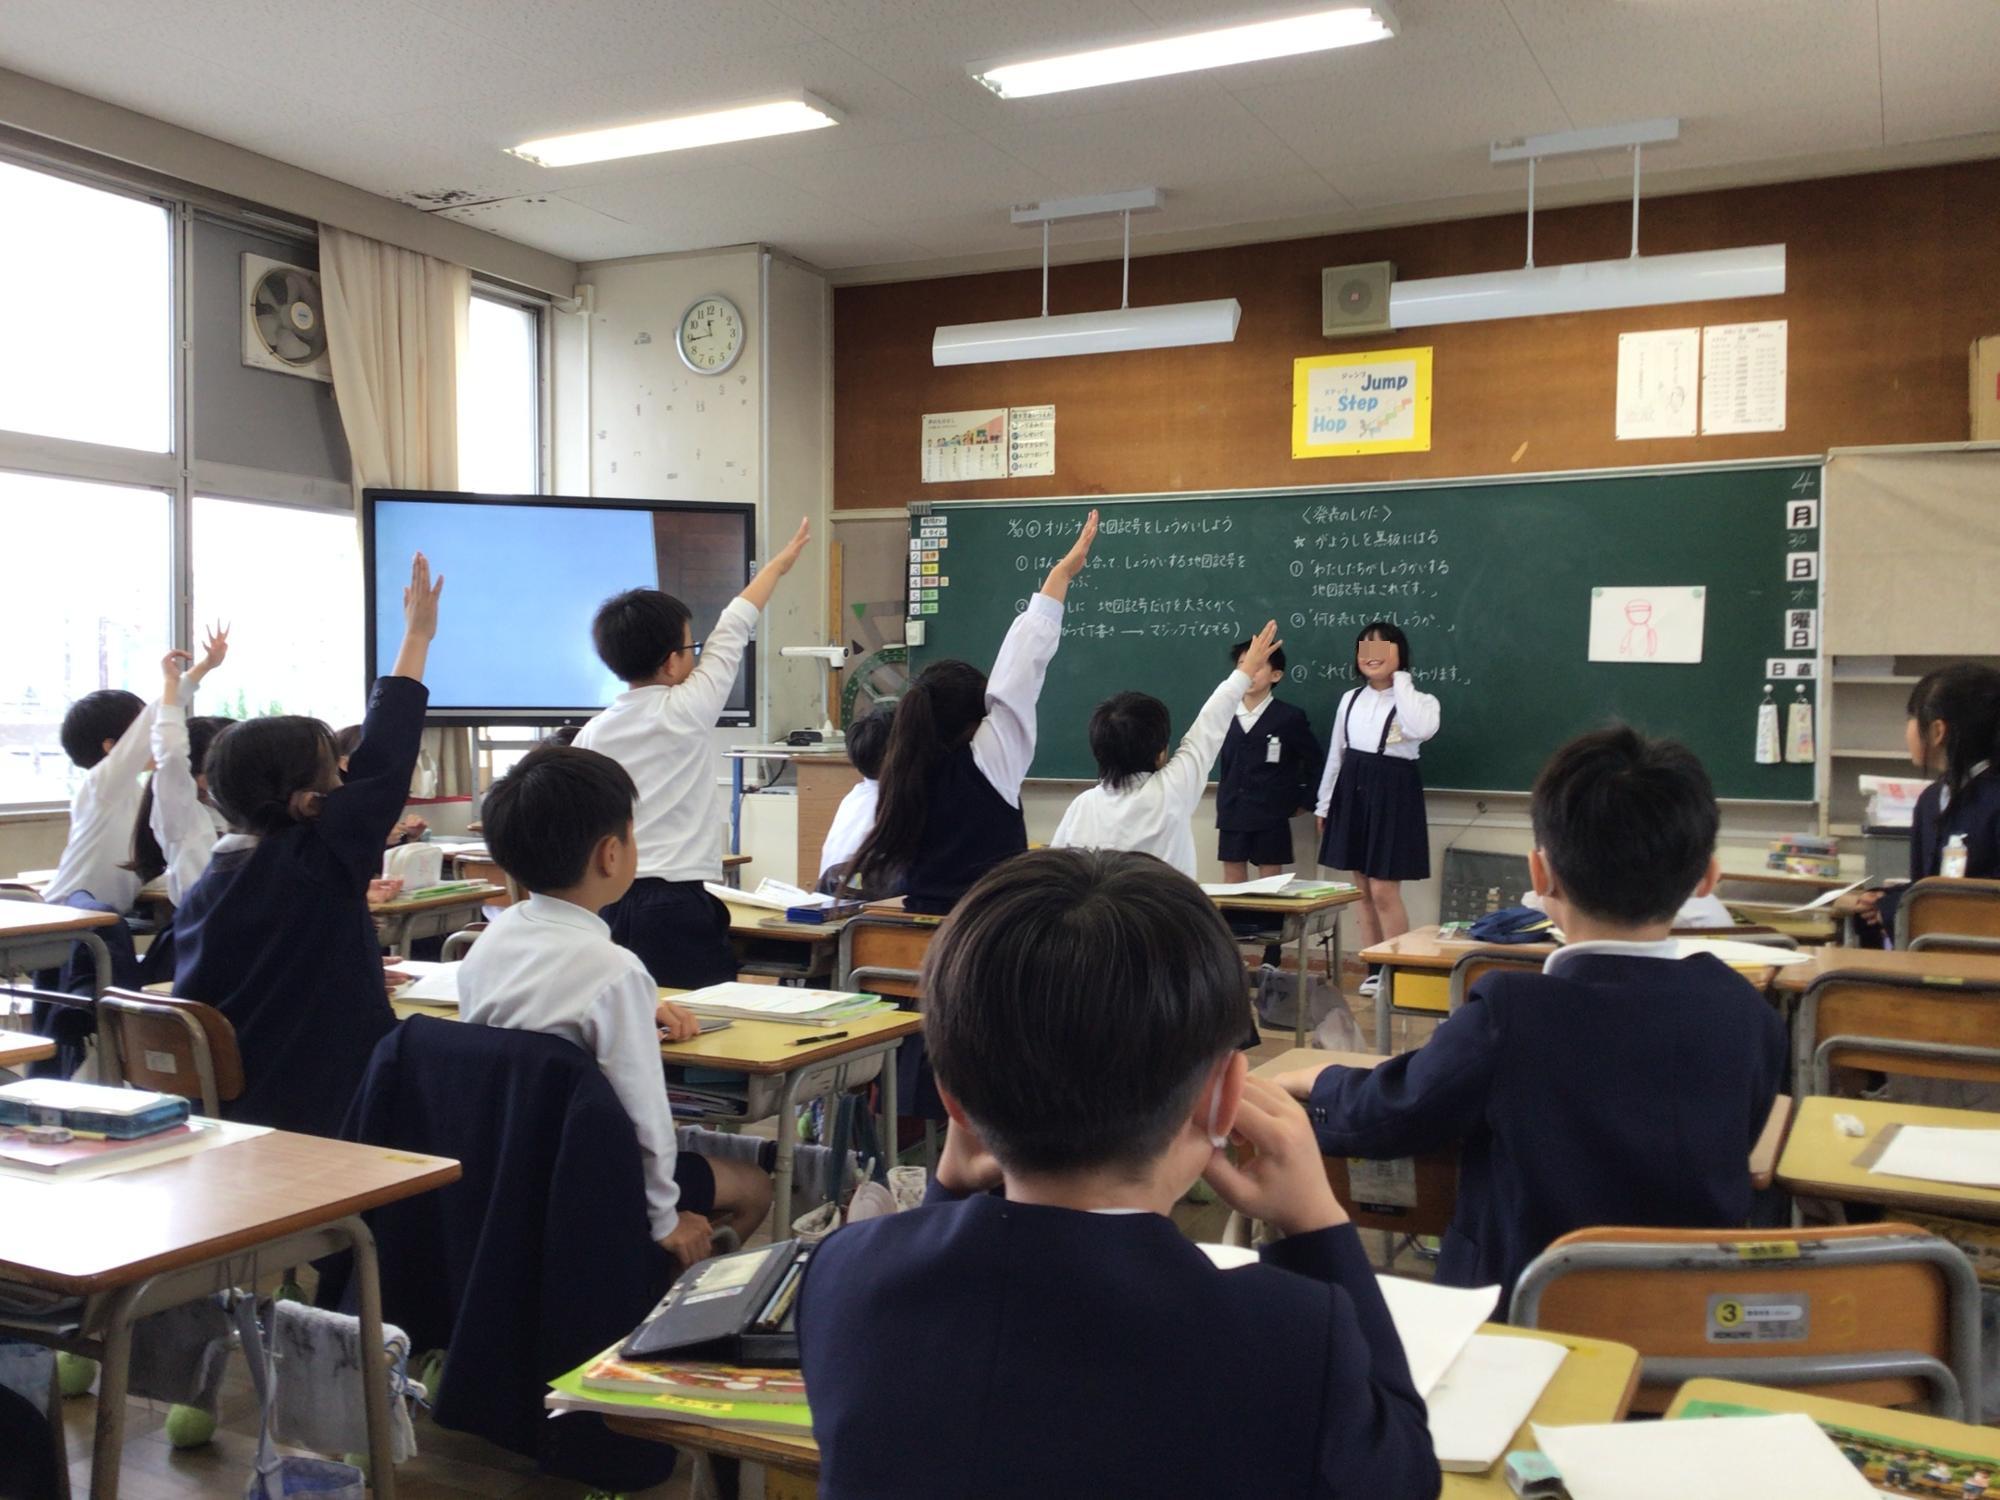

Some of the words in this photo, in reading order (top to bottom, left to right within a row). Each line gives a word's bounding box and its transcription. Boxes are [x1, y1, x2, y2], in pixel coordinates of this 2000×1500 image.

[698, 310, 704, 319] 11
[706, 305, 715, 315] 12
[690, 320, 699, 329] 10
[726, 316, 732, 326] 2
[730, 328, 736, 338] 3
[691, 346, 697, 354] 8
[708, 356, 715, 365] 6
[1360, 374, 1408, 392] Jump
[1338, 394, 1378, 413] Step
[1312, 415, 1347, 434] Hop
[1791, 471, 1815, 494] 4
[1792, 505, 1812, 527] 月
[912, 553, 919, 562] 2
[1792, 558, 1812, 579] 日
[1791, 612, 1811, 648] 曜日
[1772, 662, 1812, 677] 日直
[1722, 1304, 1737, 1322] 3
